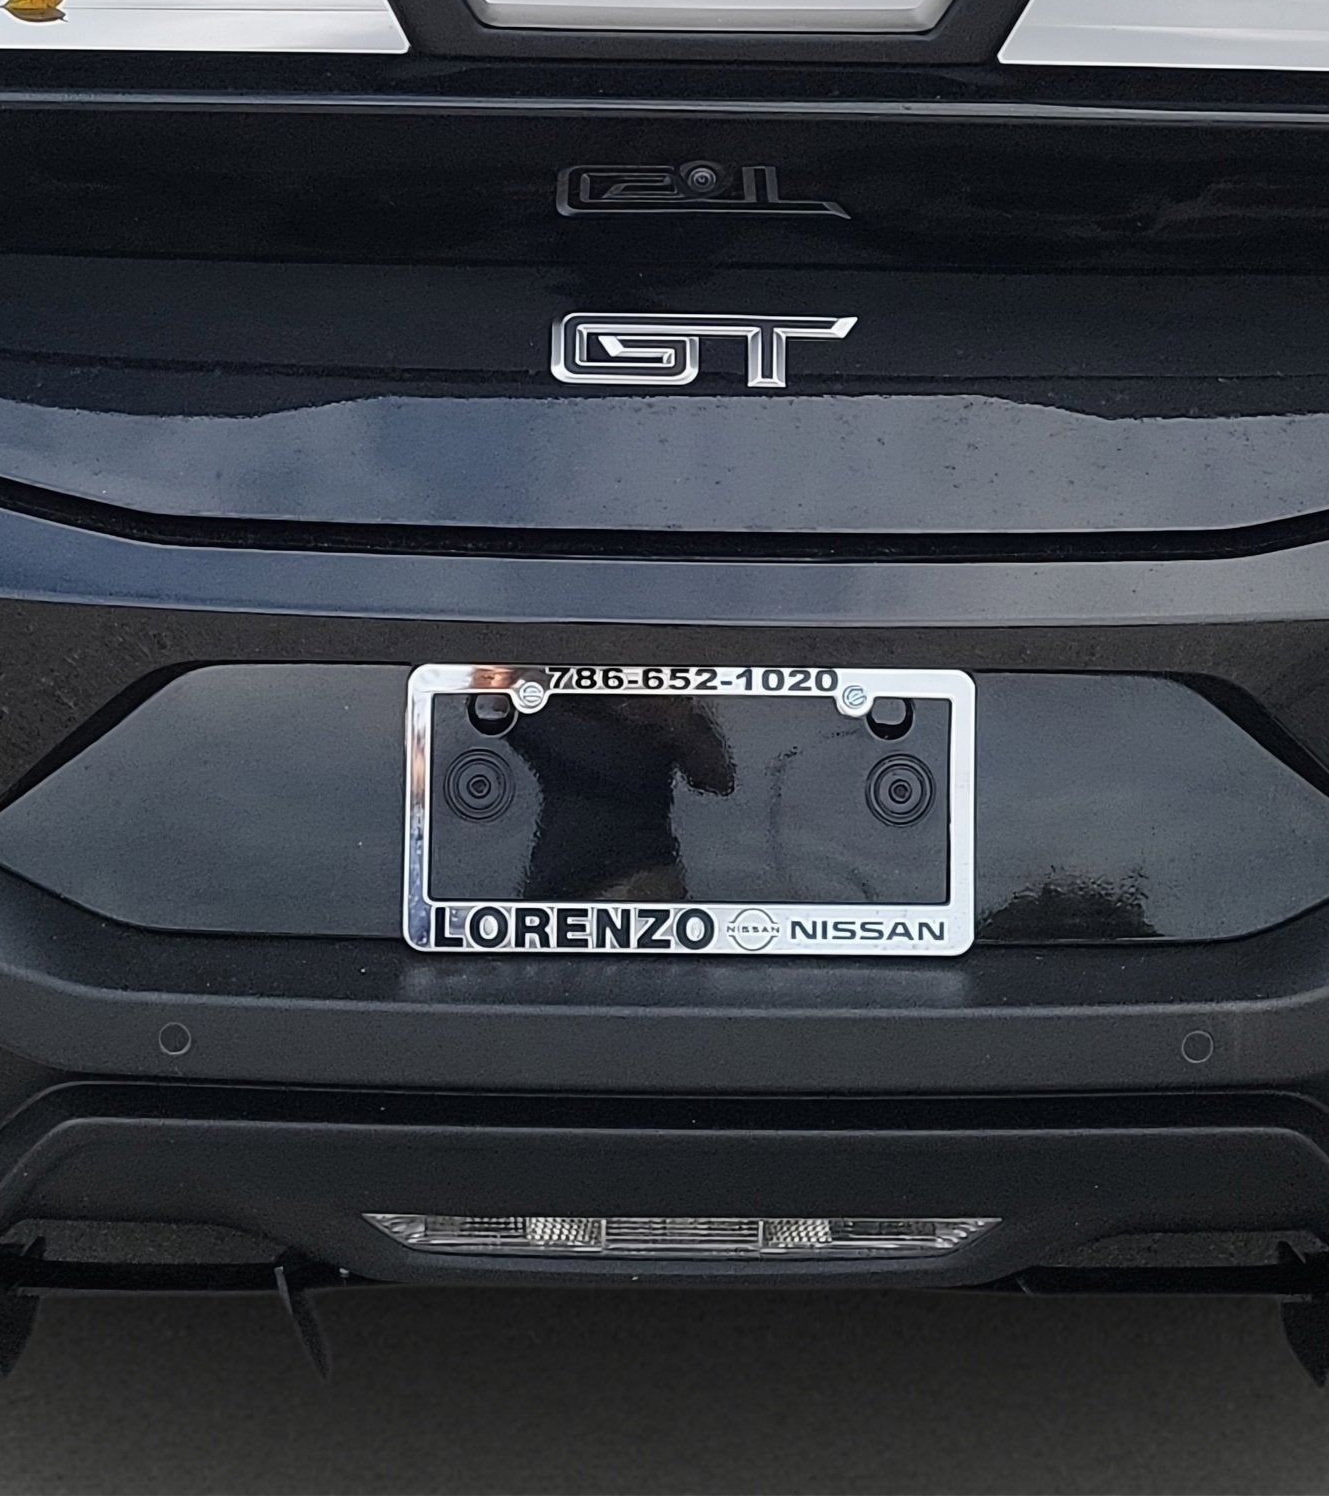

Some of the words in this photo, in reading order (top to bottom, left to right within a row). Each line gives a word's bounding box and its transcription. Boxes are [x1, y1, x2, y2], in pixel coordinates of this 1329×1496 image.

[551, 312, 858, 388] GT
[548, 666, 839, 692] 786-652-1020
[433, 907, 716, 950] LORENZO
[790, 920, 946, 941] NISSAN
